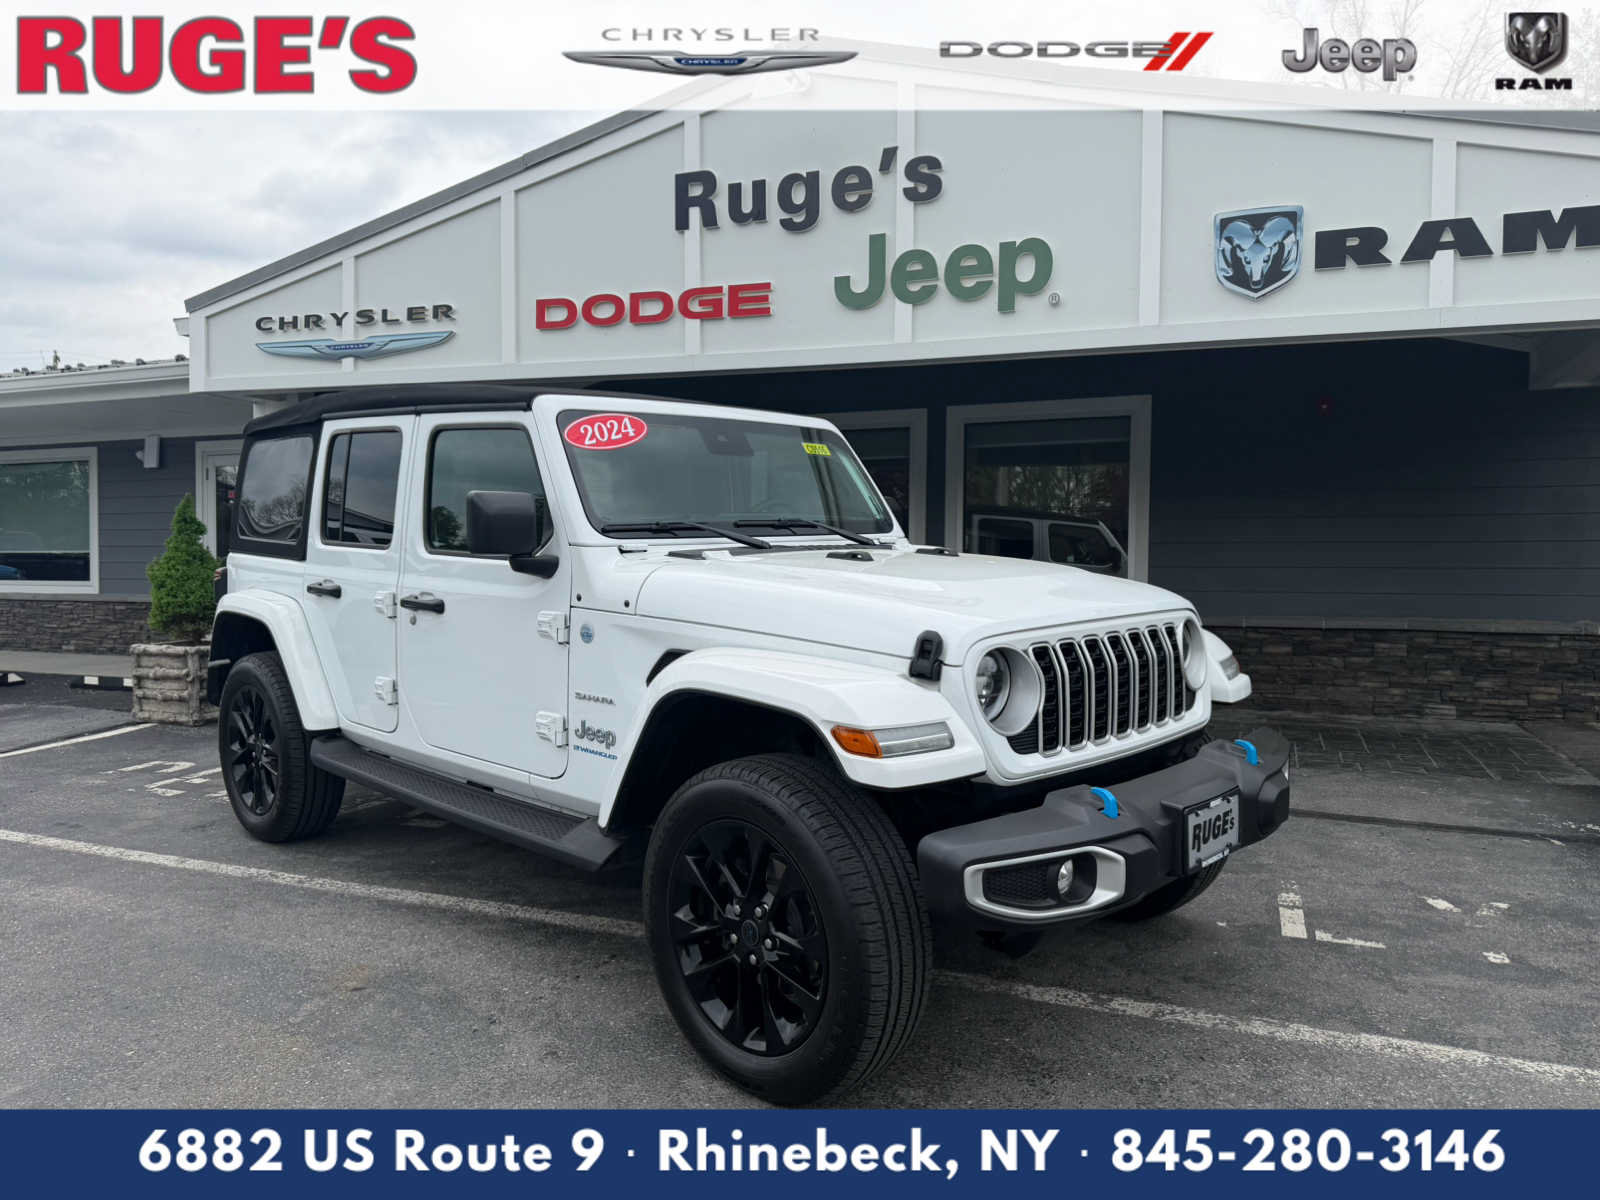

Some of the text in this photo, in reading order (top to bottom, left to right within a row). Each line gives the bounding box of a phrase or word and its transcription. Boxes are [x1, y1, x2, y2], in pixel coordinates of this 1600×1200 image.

[674, 145, 944, 233] Ruge's
[1314, 204, 1600, 273] RAM
[834, 232, 1054, 313] Jeep
[255, 303, 456, 333] CHRYSLER
[535, 282, 773, 331] DODGE
[579, 416, 637, 446] 2024
[574, 719, 616, 750] Jeep
